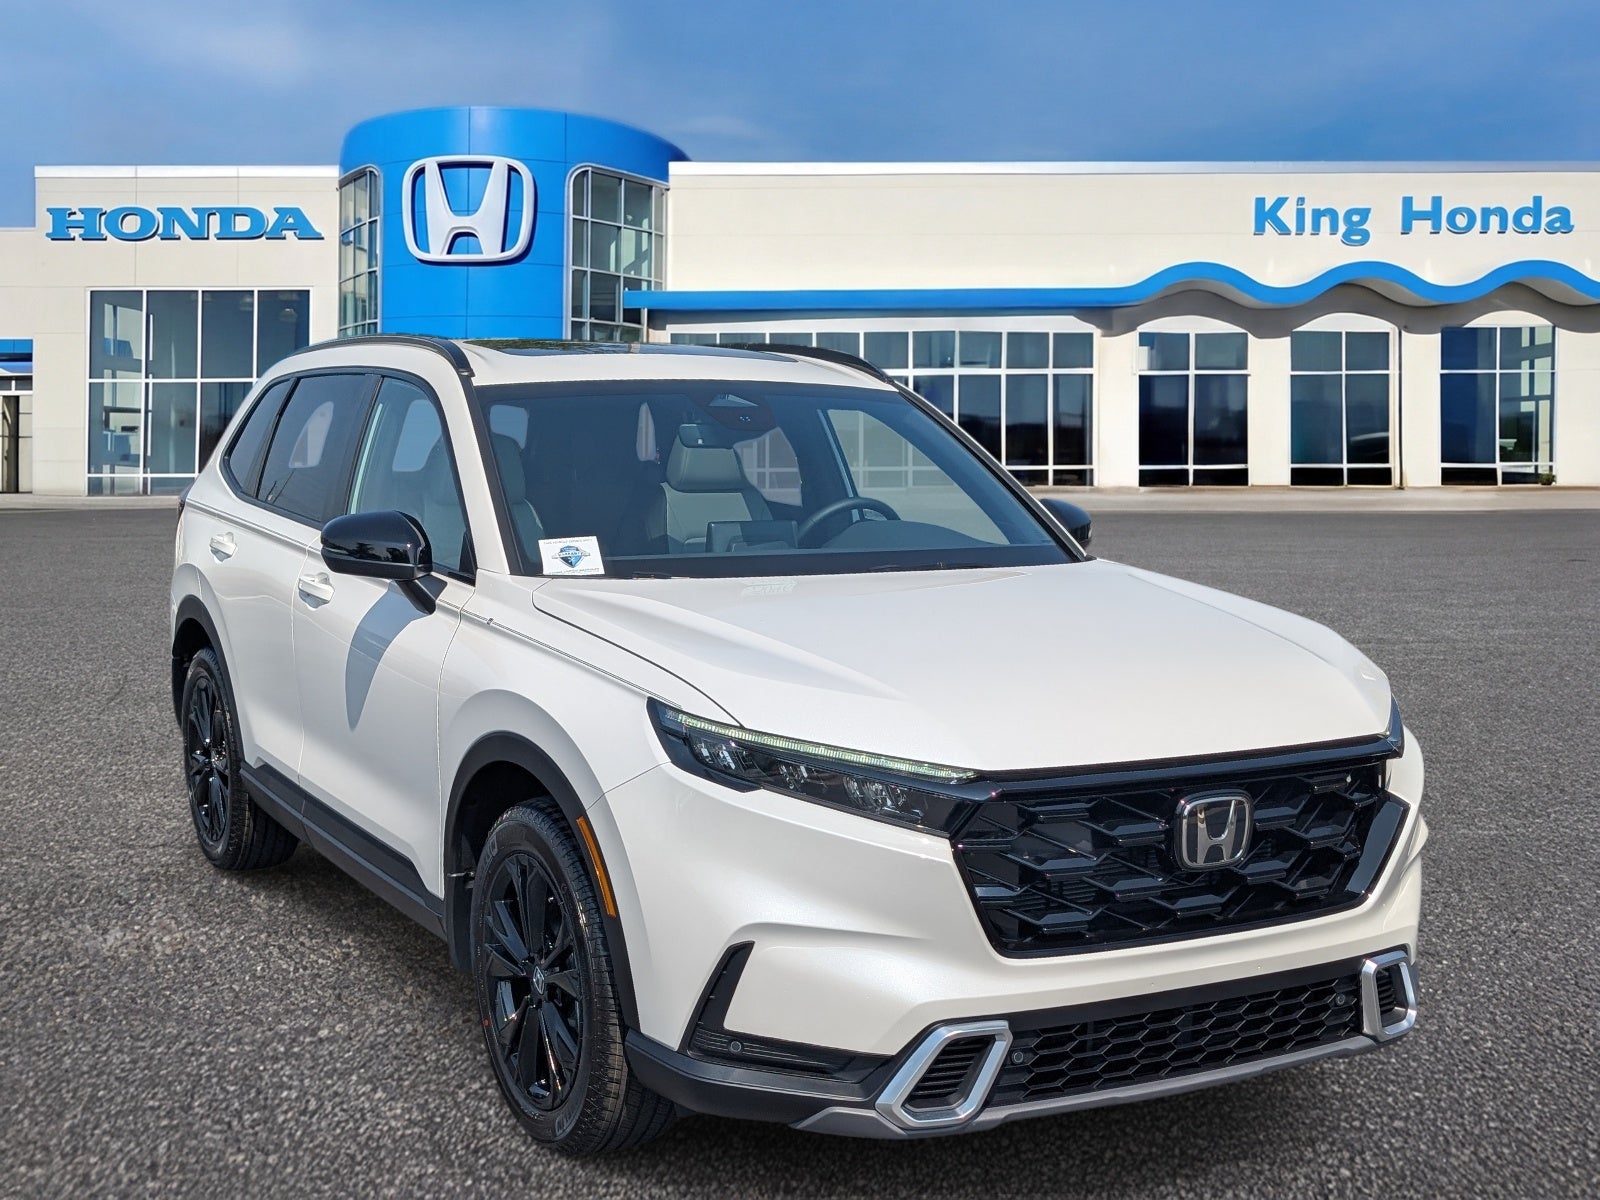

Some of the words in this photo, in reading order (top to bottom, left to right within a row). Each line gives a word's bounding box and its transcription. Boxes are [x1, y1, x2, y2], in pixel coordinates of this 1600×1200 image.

[46, 206, 324, 241] HONDA
[1253, 196, 1372, 247] King
[1400, 195, 1575, 235] Honda
